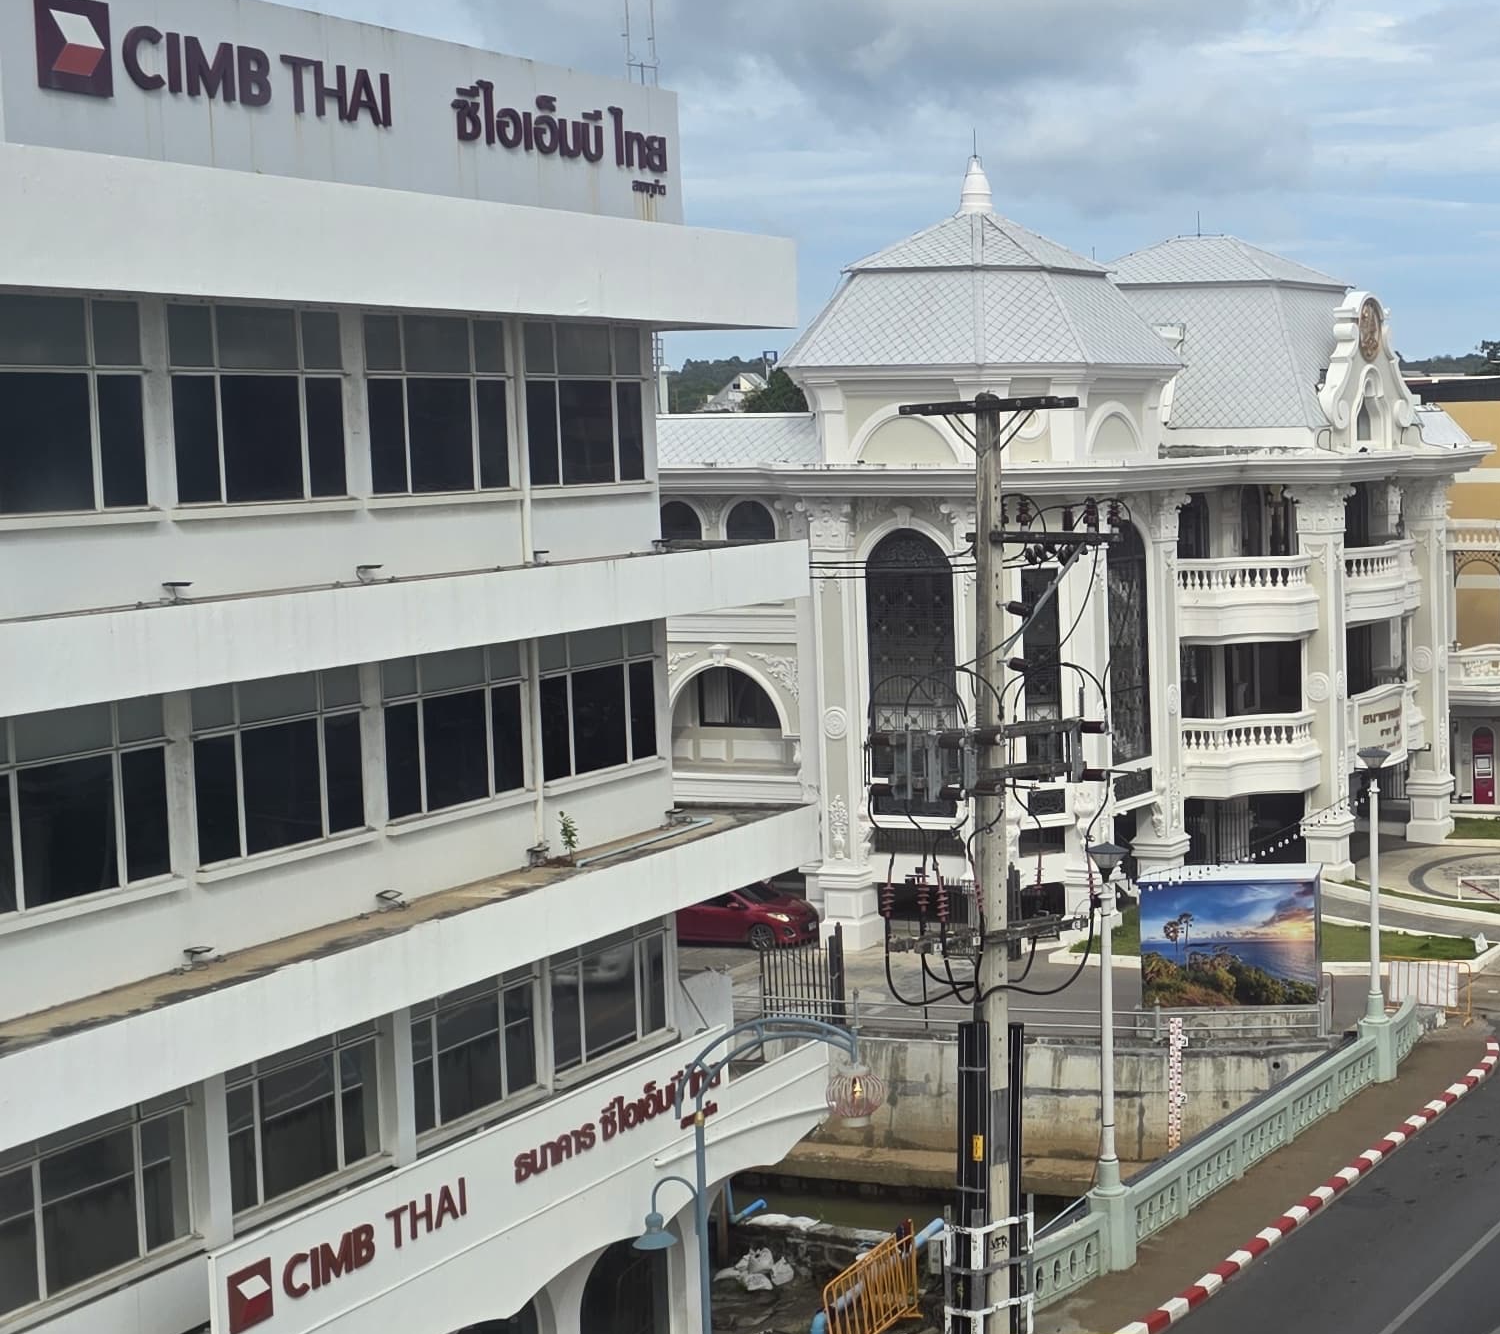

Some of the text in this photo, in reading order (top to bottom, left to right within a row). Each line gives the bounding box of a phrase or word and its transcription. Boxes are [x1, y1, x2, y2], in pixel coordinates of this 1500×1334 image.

[122, 25, 392, 128] CIMB THAI
[451, 79, 668, 173] ซีไอเอ็มบี ไทย
[514, 1122, 597, 1184] ธนาคาร
[282, 1177, 468, 1298] CIMB THAI
